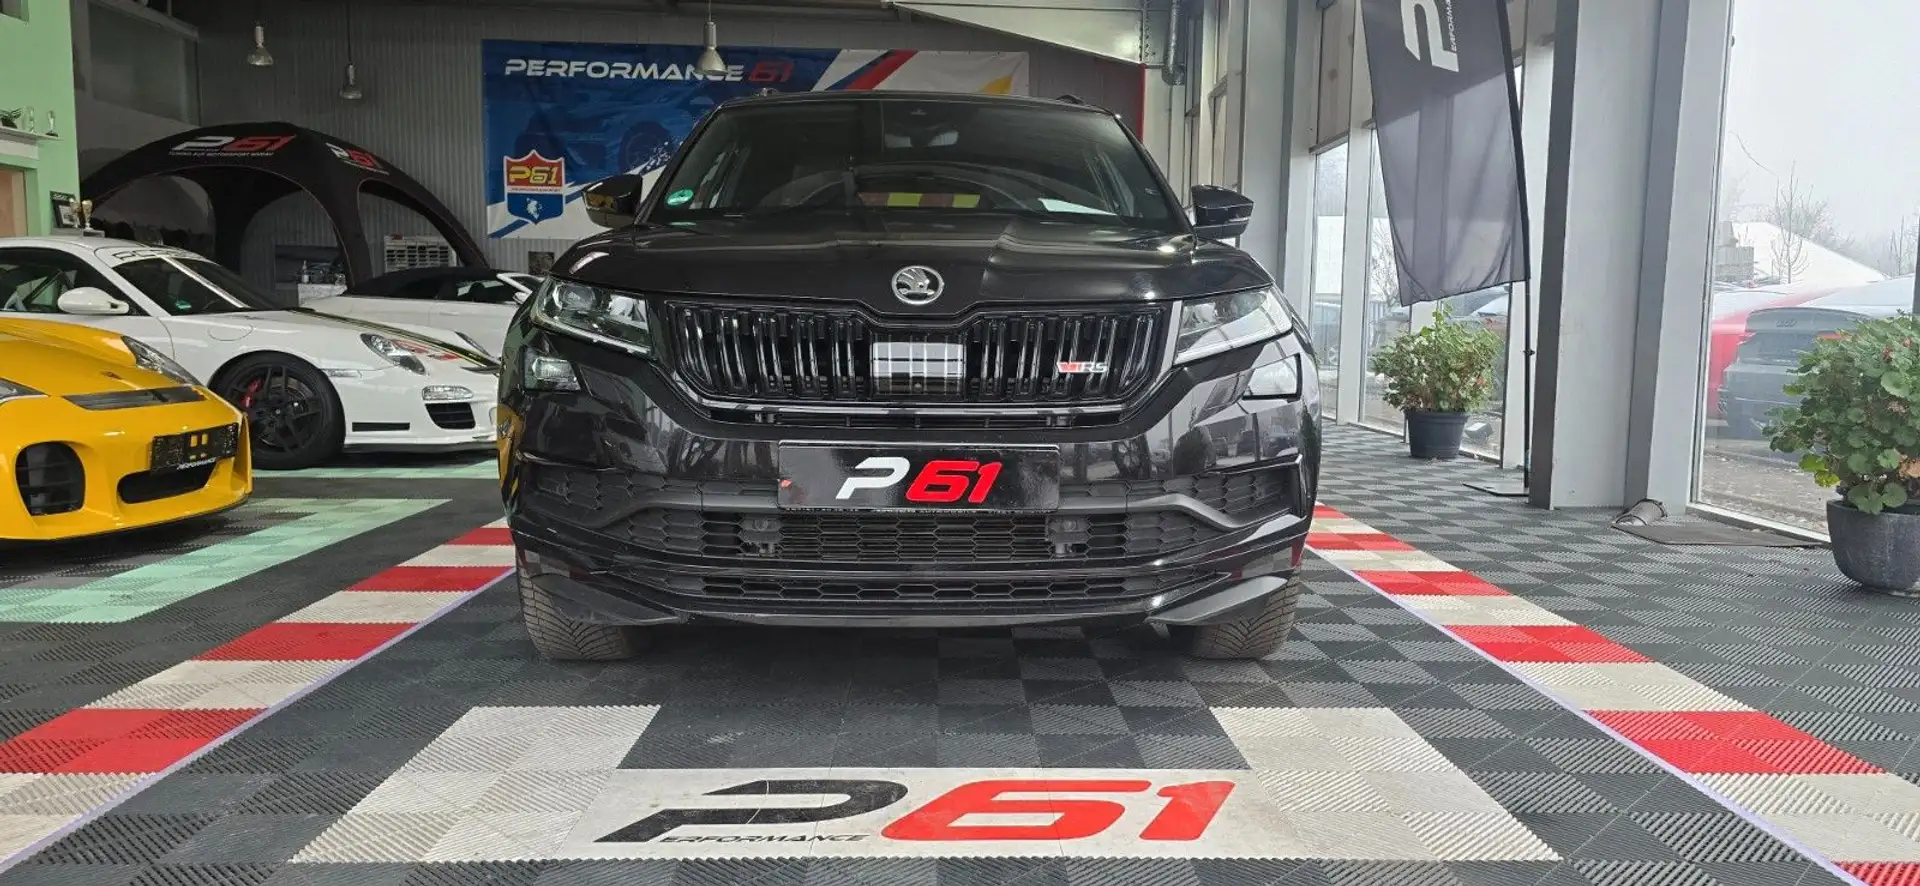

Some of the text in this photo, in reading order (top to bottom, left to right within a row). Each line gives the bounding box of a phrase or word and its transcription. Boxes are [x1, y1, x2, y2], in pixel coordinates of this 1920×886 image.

[748, 61, 793, 83] 61
[508, 165, 560, 185] P61
[835, 456, 1003, 504] P61
